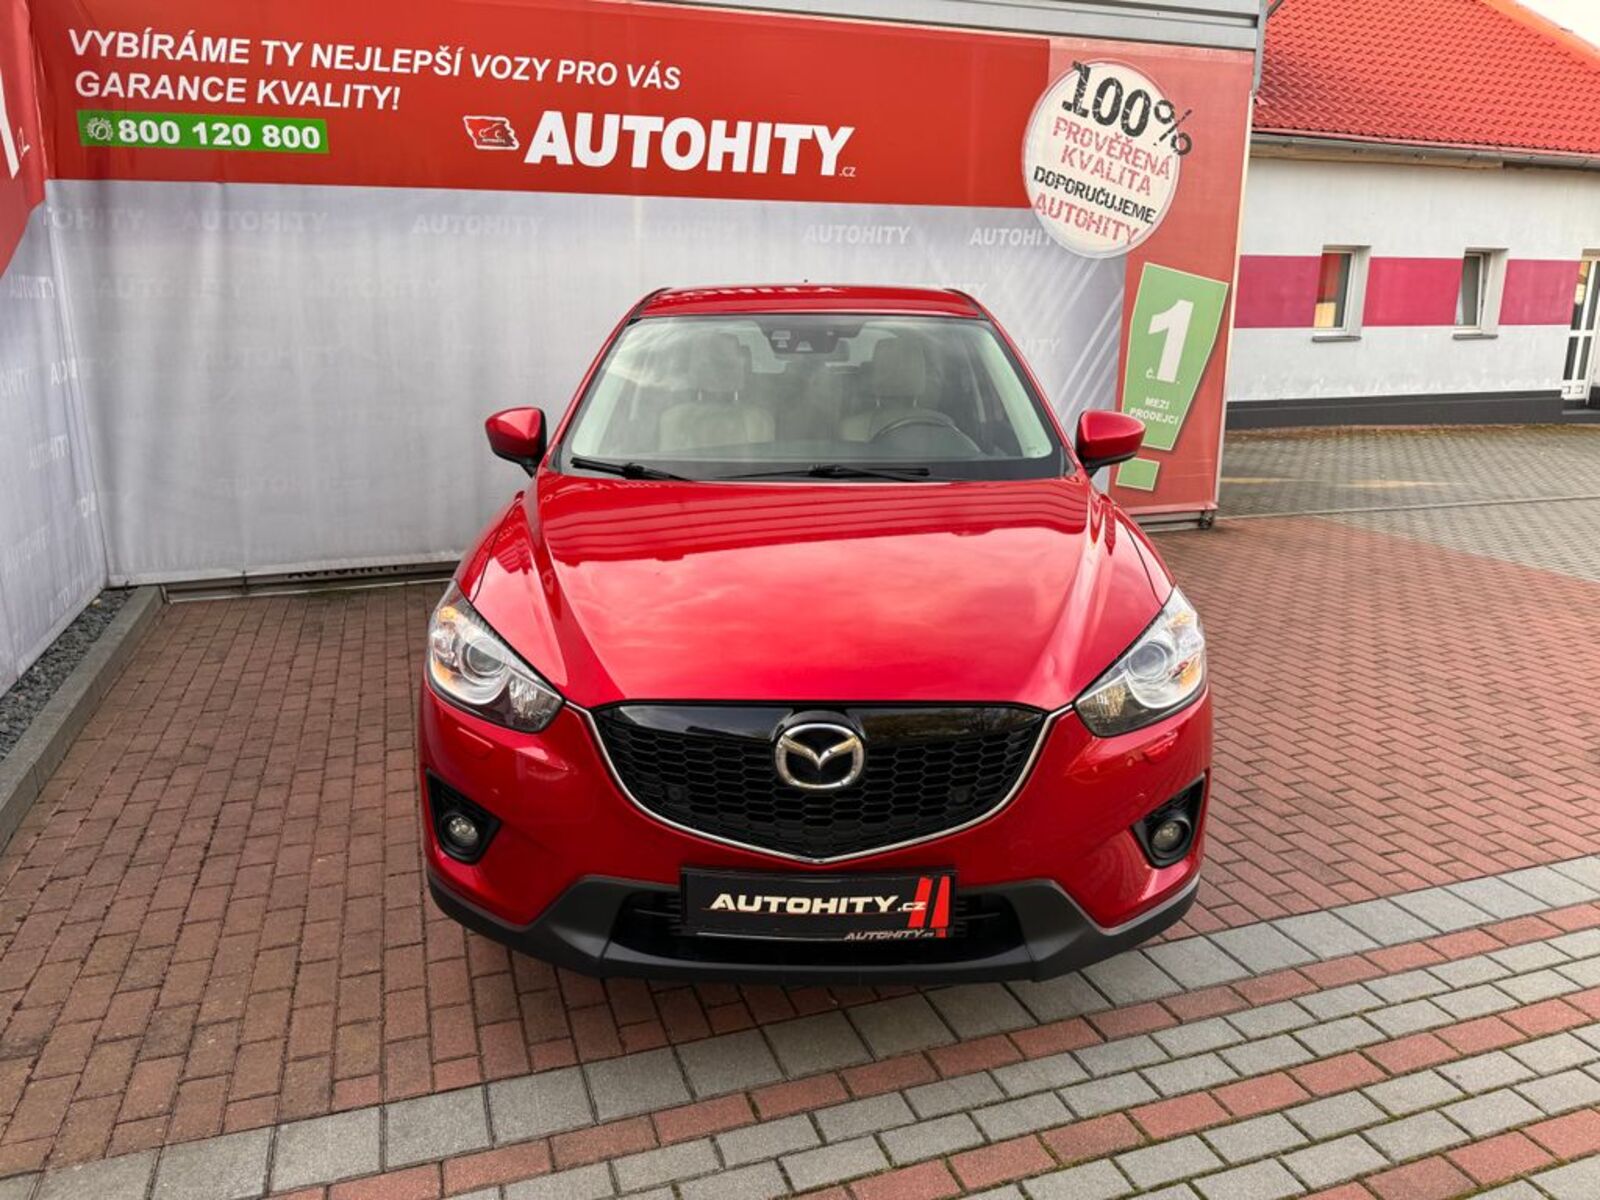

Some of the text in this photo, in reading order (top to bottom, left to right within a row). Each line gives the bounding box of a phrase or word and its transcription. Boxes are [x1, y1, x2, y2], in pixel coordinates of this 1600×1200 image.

[69, 27, 681, 90] VYBÍRÁME TY NEJLEPŠÍ VOZY PRO VÁS
[75, 70, 401, 111] GARANCE KVALITY!
[1061, 60, 1193, 156] 100%
[118, 119, 321, 150] 800 120 800
[1053, 117, 1172, 180] PROVĚŘENÁ
[1033, 166, 1157, 225] DOPORUČUJEME
[1061, 145, 1151, 196] KVALITA
[803, 224, 911, 246] AUTOHITY
[1034, 192, 1142, 246] AUTOHITY
[1128, 407, 1179, 425] PRODEJCI
[1144, 396, 1170, 410] MEZI
